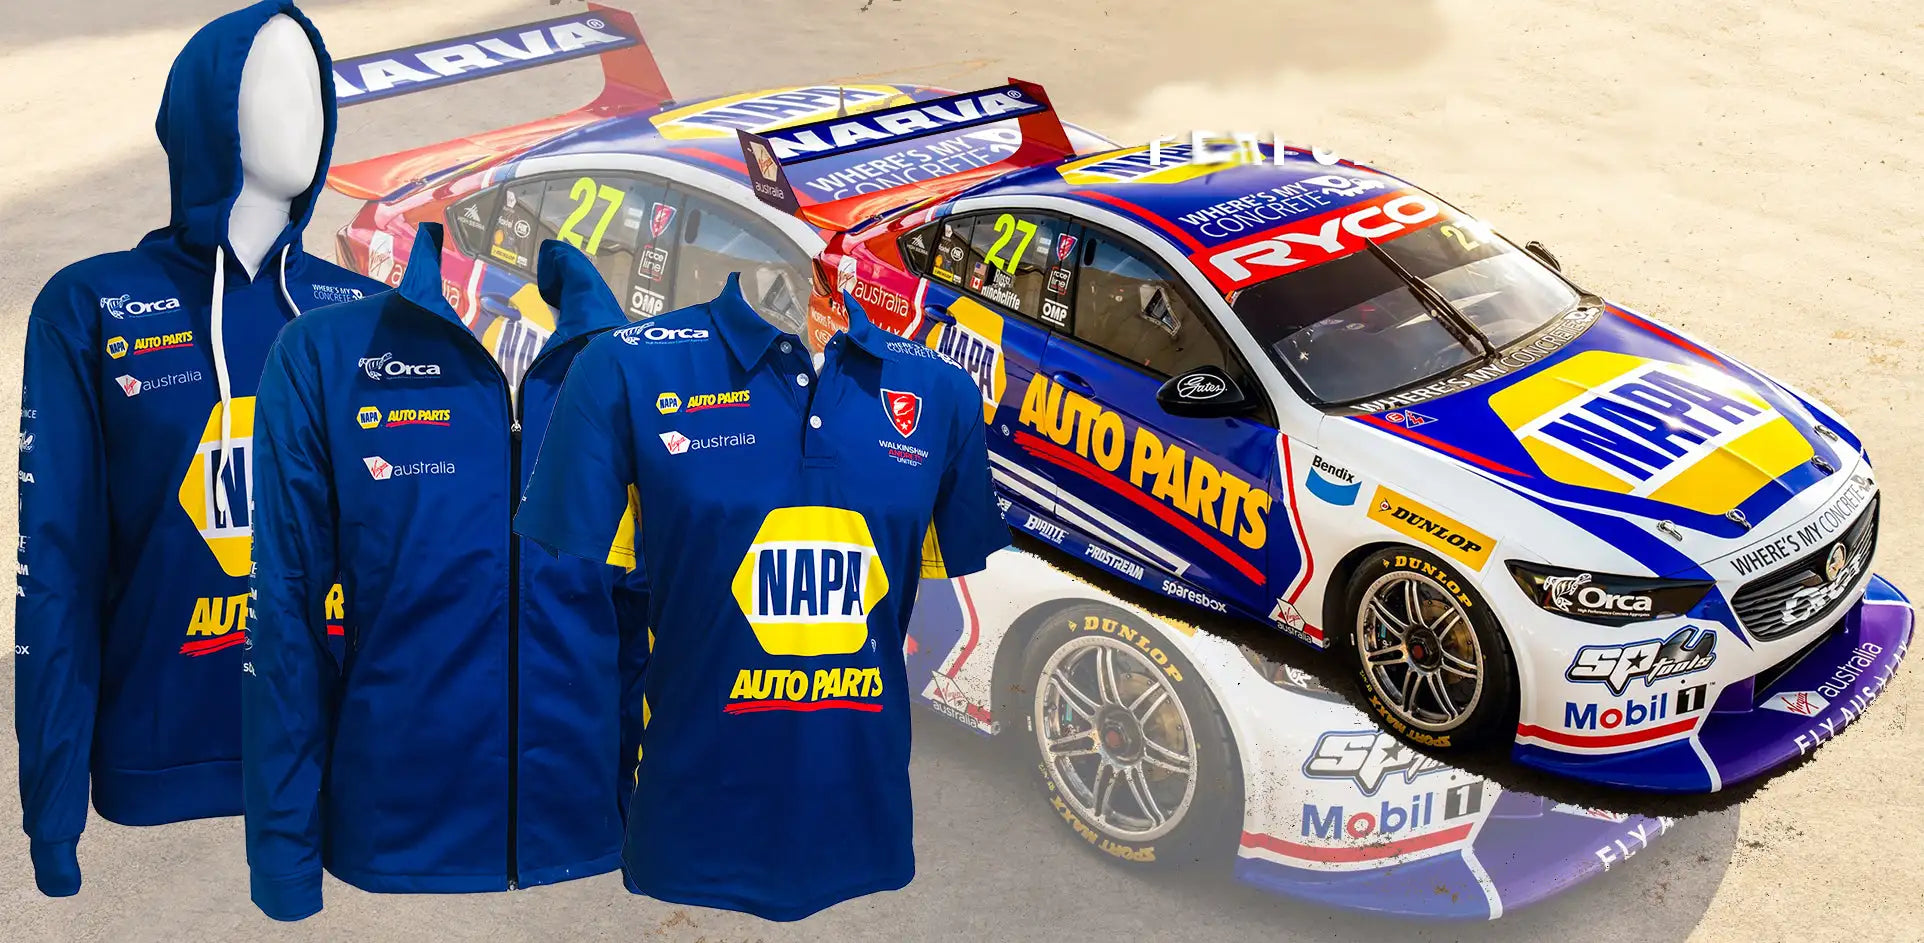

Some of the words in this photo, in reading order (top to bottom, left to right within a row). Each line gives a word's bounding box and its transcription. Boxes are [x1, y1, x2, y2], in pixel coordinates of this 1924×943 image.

[333, 22, 626, 98] ARVA
[683, 87, 873, 128] NAPA
[767, 93, 1039, 160] NARVA
[807, 150, 925, 192] WHERE'S
[929, 137, 972, 157] MY
[755, 181, 785, 199] australia
[1178, 191, 1277, 227] WHERE'S
[1279, 181, 1312, 200] MY
[557, 177, 625, 255] 27
[1200, 189, 1331, 238] CONCRETE
[985, 213, 1037, 275] 27
[1209, 195, 1439, 282] RYCO
[312, 284, 339, 293] WHERE'S
[314, 291, 351, 302] CONCRETE
[632, 291, 664, 315] OMP
[854, 281, 909, 317] australia
[125, 298, 180, 315] Orca
[1042, 302, 1068, 322] OMP
[109, 341, 126, 354] NAPA
[134, 336, 161, 350] AUTO
[162, 331, 193, 346] PARTS
[644, 327, 709, 340] Orca
[385, 361, 441, 376] Orca
[938, 323, 995, 400] NAPA
[1351, 377, 1471, 412] WHERE'S
[1466, 363, 1506, 387] MY
[1501, 318, 1584, 372] CONCRETE
[142, 370, 202, 391] australia
[1182, 376, 1225, 399] Gates
[388, 409, 416, 422] AUTO
[418, 409, 450, 421] PARTS
[660, 397, 678, 409] NAPA
[687, 394, 716, 408] AUTO
[718, 390, 750, 405] PARTS
[360, 412, 379, 424] NAPA
[1538, 370, 1761, 482] NAPA
[691, 433, 756, 449] australia
[879, 440, 929, 458] WALKINSHAW
[394, 461, 455, 477] australia
[1018, 372, 1126, 472] AUTO
[1130, 426, 1272, 550] PARTS
[1312, 455, 1355, 483] Bendix
[1024, 514, 1068, 541] BIANTE
[1391, 507, 1482, 553] DUNLOP
[1730, 540, 1801, 577] WHERE'S
[1800, 522, 1822, 548] MY
[1821, 485, 1865, 533] CONCRETE
[1085, 543, 1144, 580] PROSTREAM
[758, 549, 863, 616] NAPA
[1162, 579, 1227, 613] sparesbox
[1395, 555, 1472, 608] DUNLOP
[186, 593, 248, 636] AUT
[1577, 587, 1652, 611] Orca
[1084, 616, 1184, 682] DUNLOP
[1277, 621, 1312, 643] australia
[729, 669, 810, 702] AUTO
[811, 667, 883, 701] PARTS
[1649, 654, 1713, 685] tools
[1817, 642, 1883, 698] australia
[933, 701, 977, 728] australia
[1564, 692, 1668, 730] Mobil
[1406, 730, 1451, 748] SPORT
[1793, 717, 1835, 755] FLY
[1301, 791, 1434, 840] Mobil
[1456, 785, 1470, 815] 1
[1595, 823, 1648, 872] FLY
